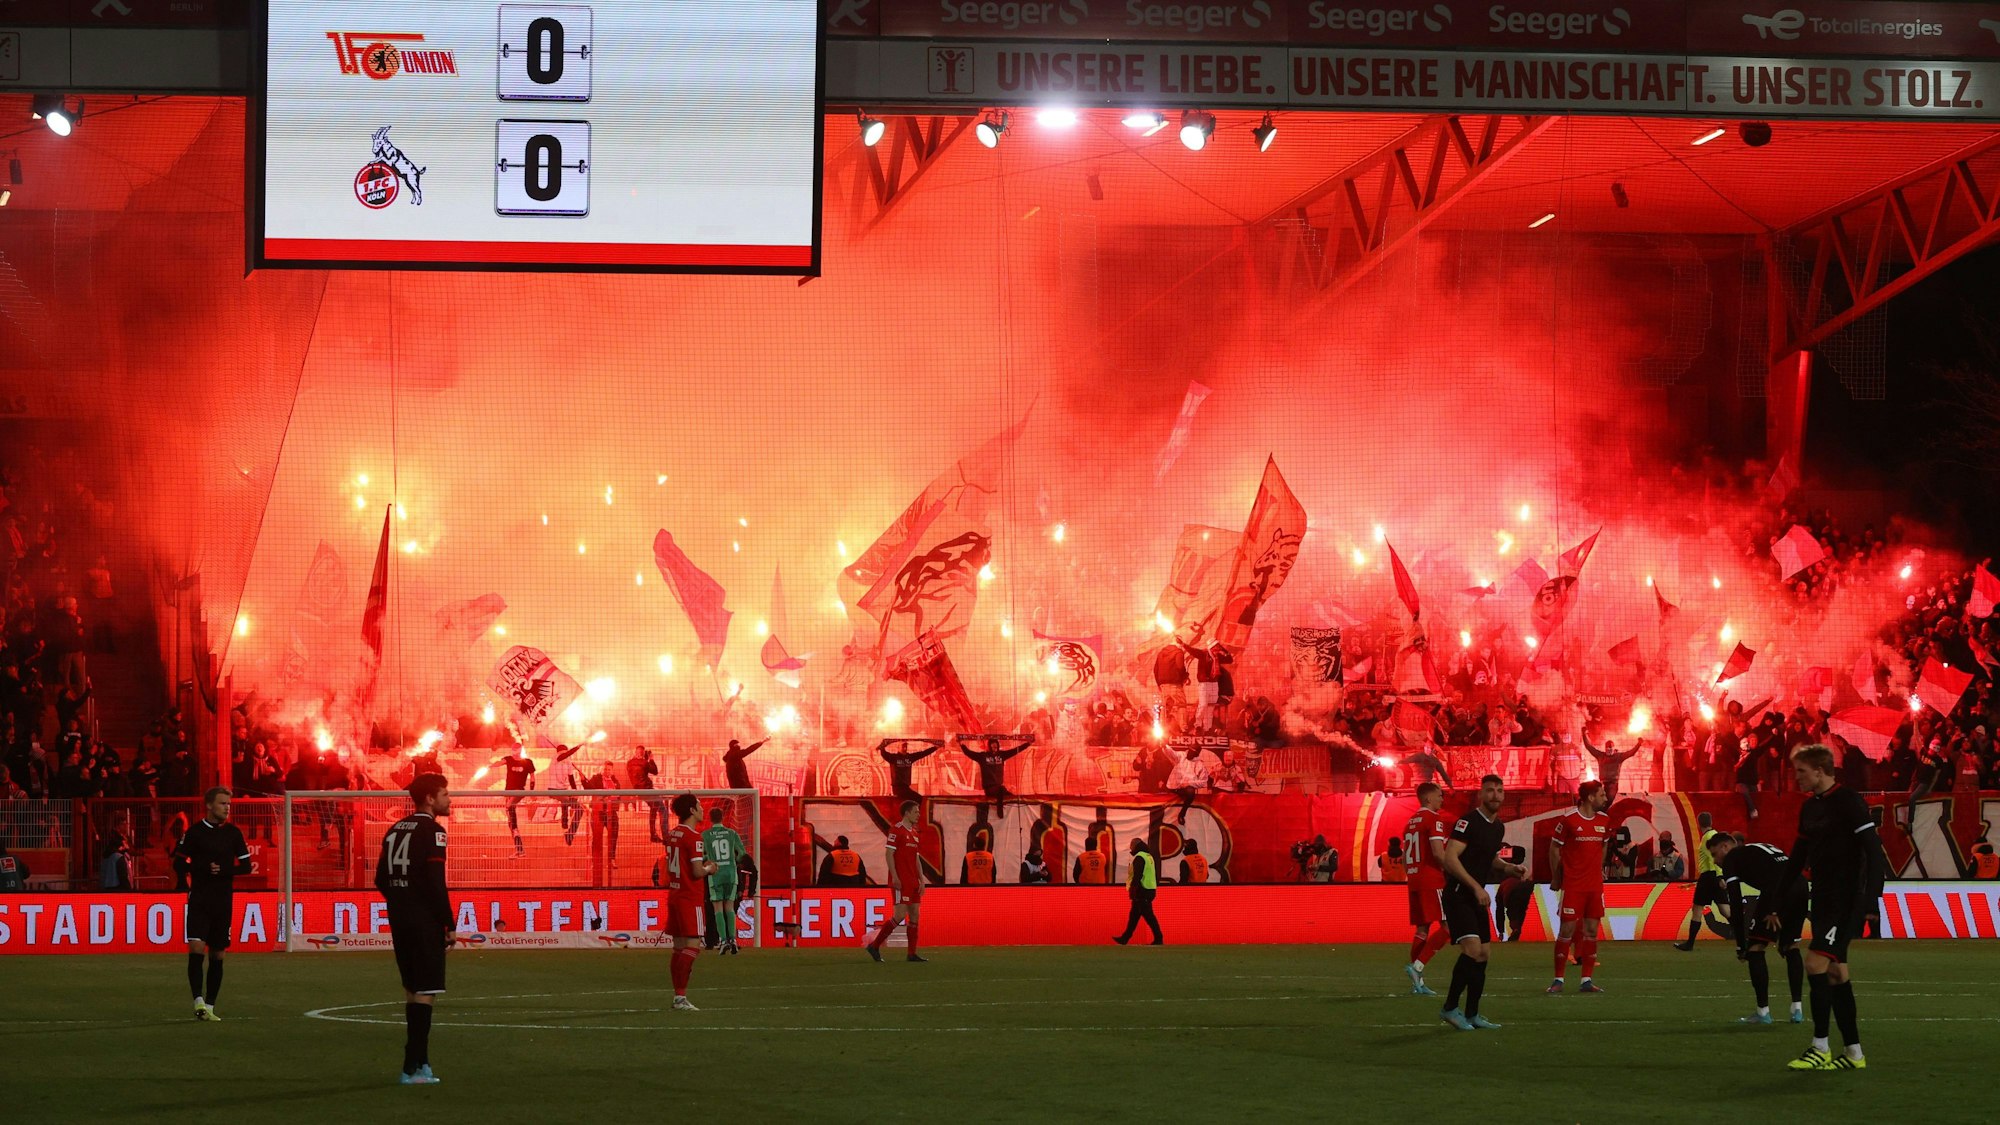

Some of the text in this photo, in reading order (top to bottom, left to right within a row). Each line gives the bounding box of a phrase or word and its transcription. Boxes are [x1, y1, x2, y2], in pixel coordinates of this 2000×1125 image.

[941, 0, 1051, 29] Seeger
[1126, 0, 1237, 32] Seeger
[1308, 1, 1418, 36] Seeger
[1489, 5, 1598, 40] Seeger
[1809, 17, 1943, 40] TotalEnergies
[401, 51, 456, 74] UNION
[527, 16, 564, 85] 0
[997, 51, 1984, 109] UNSERE LIEBE. UNSERE MANNSCHAFT. UNSER STOLZ.
[525, 134, 562, 202] 0
[1168, 735, 1229, 746] HORDE
[386, 832, 412, 875] 14
[712, 839, 730, 860] 19
[1405, 831, 1420, 864] 21
[0, 904, 189, 944] TADIO
[1825, 926, 1837, 945] 4
[488, 935, 560, 946] TotalEnergies
